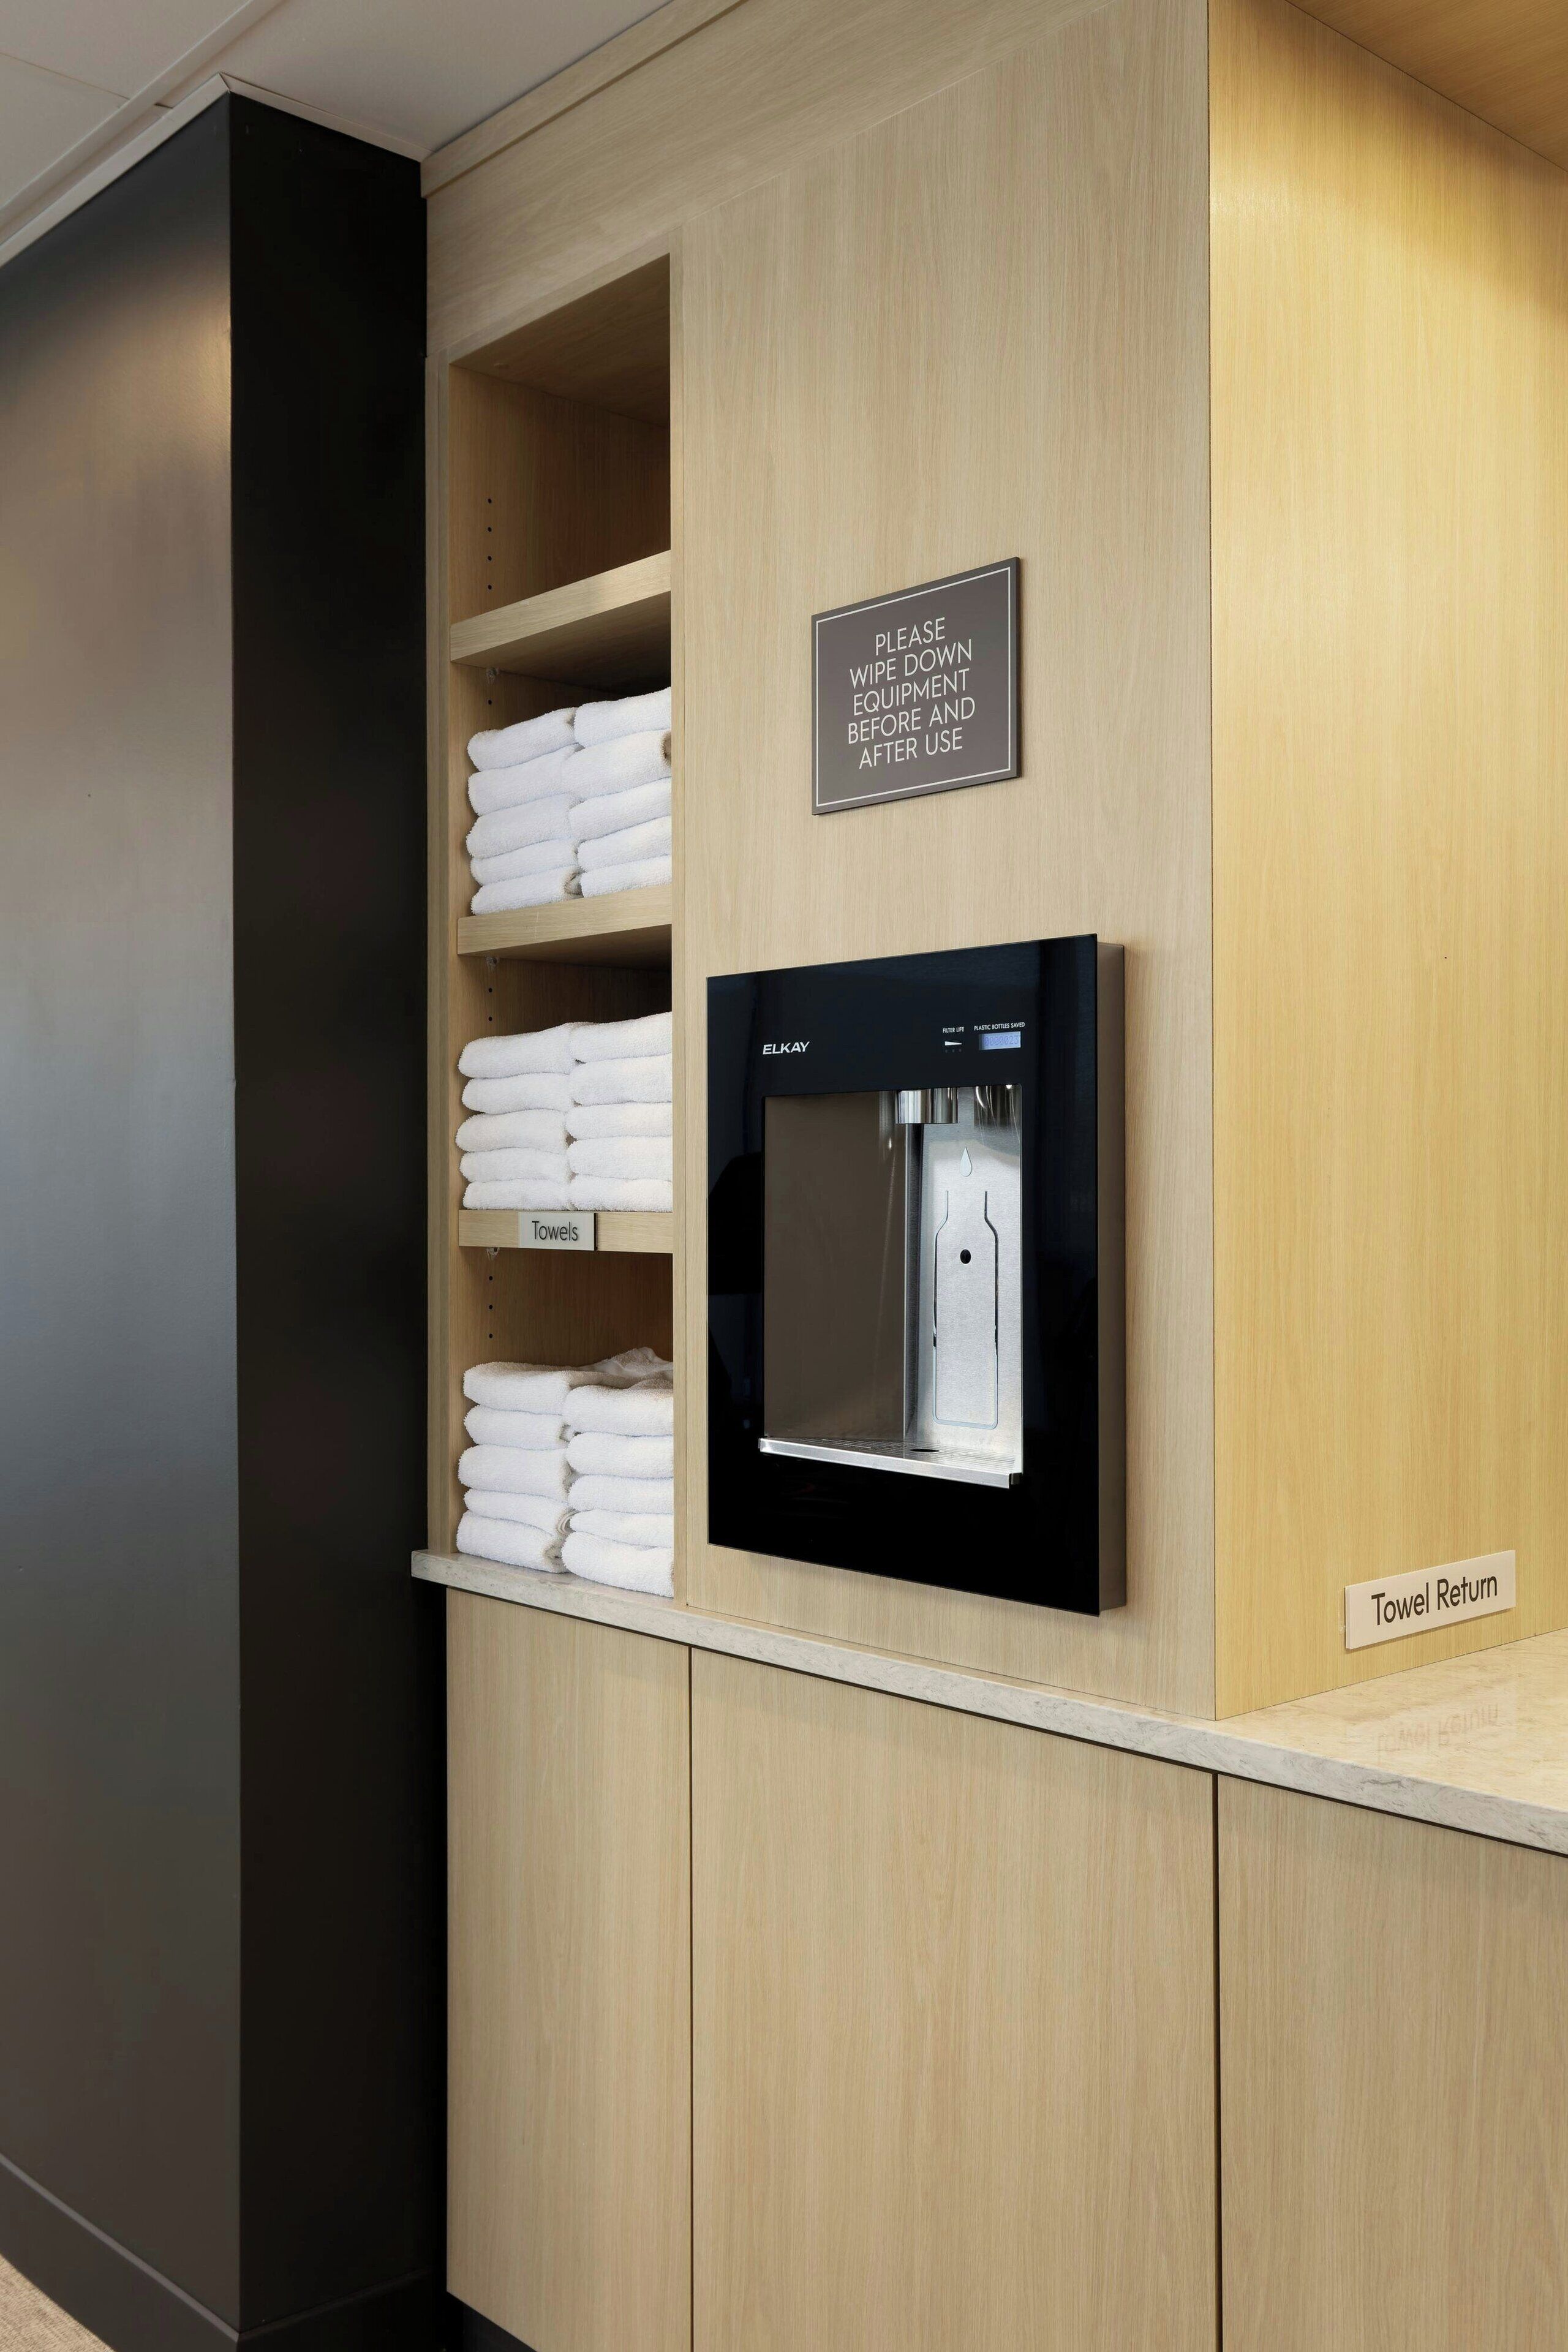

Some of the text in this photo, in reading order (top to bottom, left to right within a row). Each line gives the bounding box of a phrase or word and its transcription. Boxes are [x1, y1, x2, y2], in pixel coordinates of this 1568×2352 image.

[876, 617, 945, 655] PLEASE
[850, 638, 972, 689] WIPE DOWN
[854, 668, 970, 716] EQUIPMENT
[848, 696, 975, 744] BEFORE AND
[859, 727, 963, 769] AFTER USE
[763, 1041, 810, 1055] ELKAY
[532, 1221, 578, 1241] Towels
[1371, 1575, 1498, 1626] Towel Return
